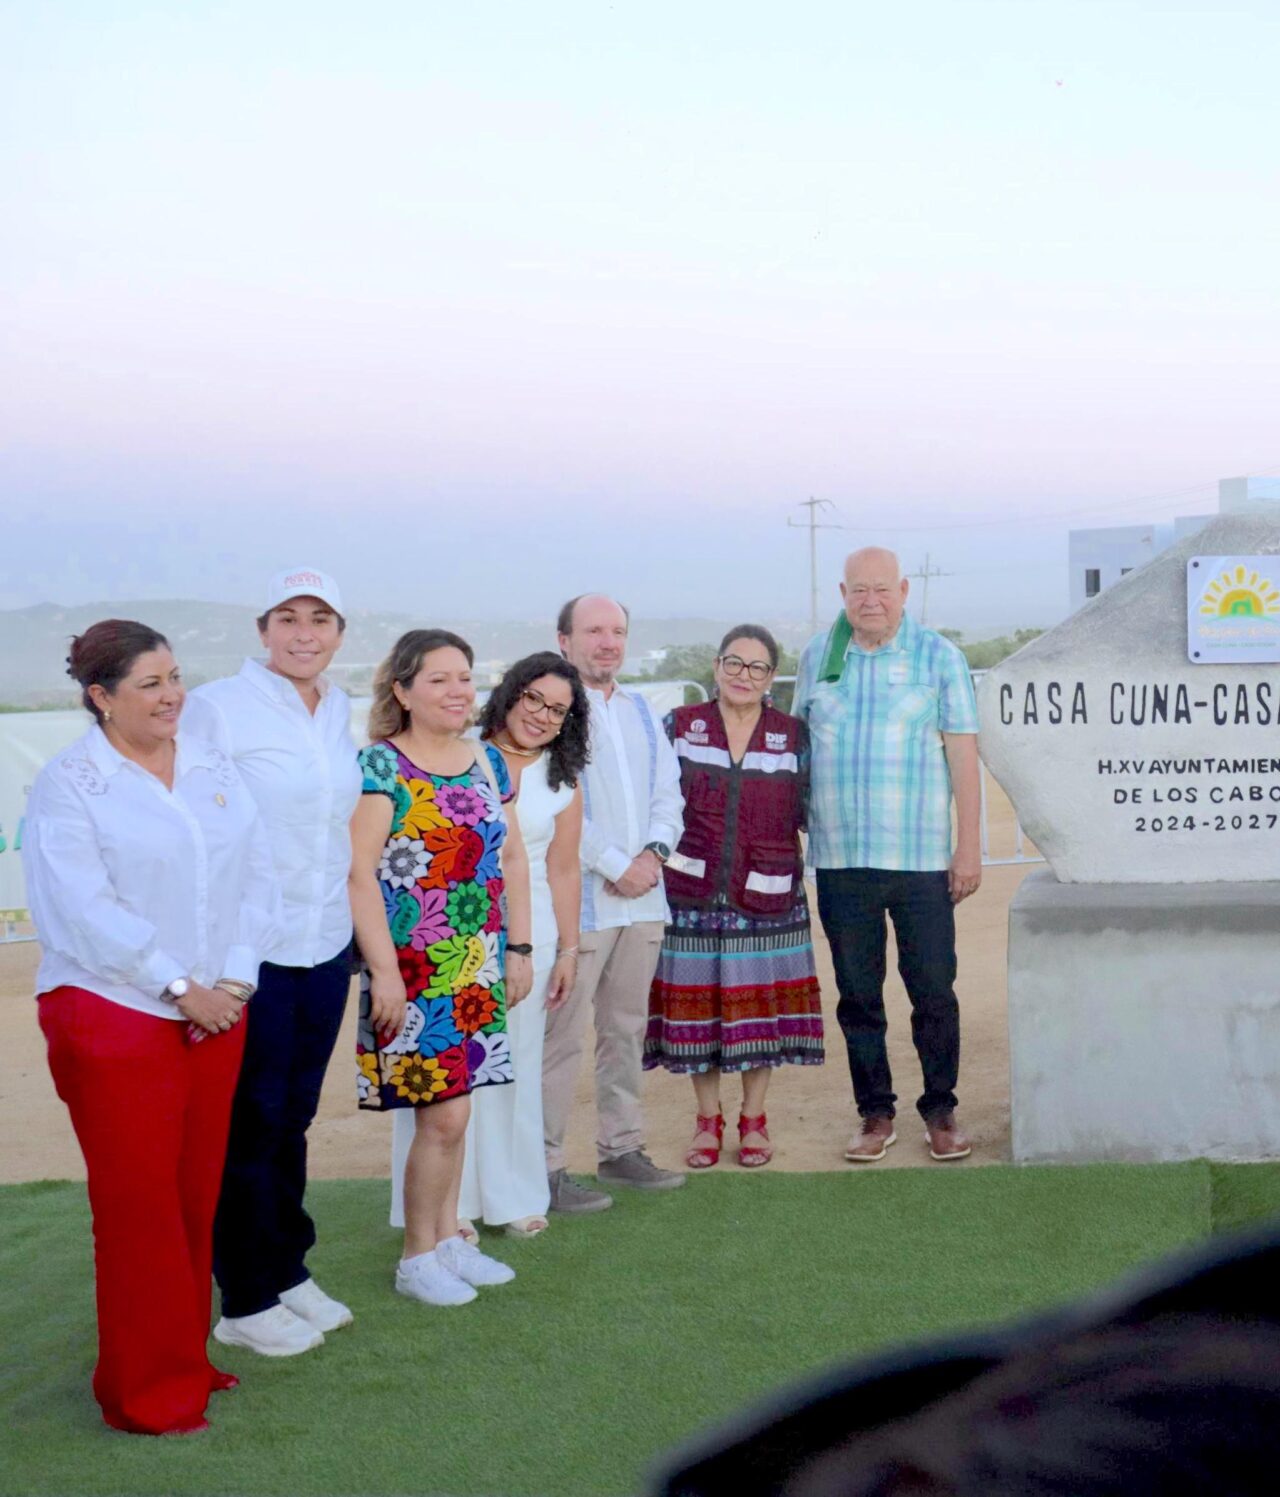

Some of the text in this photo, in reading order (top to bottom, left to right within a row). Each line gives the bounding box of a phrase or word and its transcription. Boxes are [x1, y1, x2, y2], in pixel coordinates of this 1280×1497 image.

[1000, 682, 1088, 725] CASA
[765, 732, 787, 744] DIF
[1113, 788, 1143, 804] DE
[1152, 787, 1198, 804] LOS
[1135, 814, 1279, 833] 2024-2027
